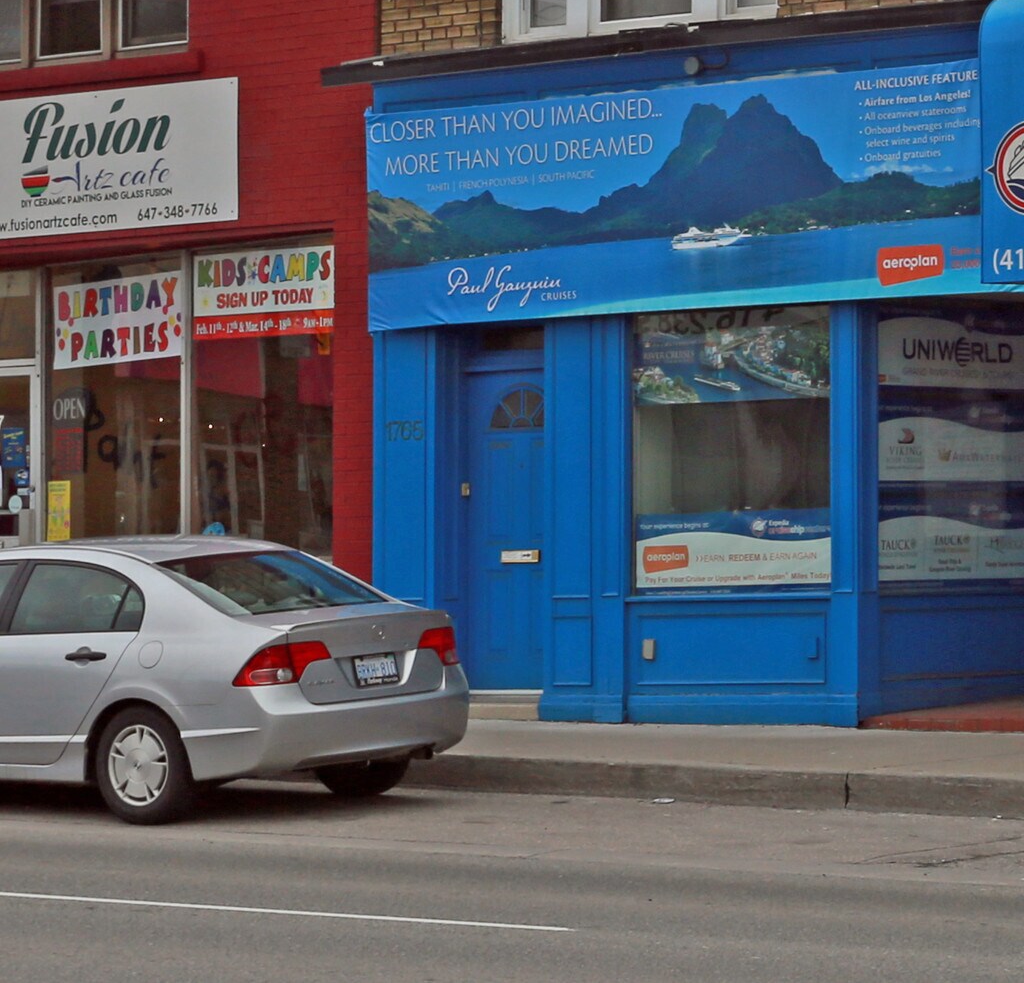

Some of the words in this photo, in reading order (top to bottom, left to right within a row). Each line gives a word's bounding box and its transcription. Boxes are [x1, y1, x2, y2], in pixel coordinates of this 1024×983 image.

[854, 75, 929, 91] ALL-INCLUSIVE
[863, 96, 895, 107] Airfare
[896, 94, 917, 105] from
[919, 93, 933, 102] Los
[934, 89, 971, 103] Angeles!
[864, 111, 876, 121] All
[877, 109, 919, 120] oceanview
[921, 105, 967, 117] staterooms
[22, 98, 171, 164] Fusion
[369, 117, 436, 144] CLOSER
[440, 113, 497, 137] THAN
[500, 106, 546, 131] YOU
[864, 124, 901, 136] Onboard
[902, 122, 943, 133] beverages
[866, 138, 889, 148] select
[891, 136, 911, 146] wine
[912, 134, 928, 144] and
[929, 133, 956, 145] spirits
[384, 151, 441, 177] MORE
[444, 147, 500, 172] THAN
[504, 142, 549, 166] YOU
[554, 132, 655, 163] DREAMED
[864, 152, 901, 163] Onboard
[902, 149, 941, 161] gratuities
[51, 160, 114, 193] Artz
[119, 157, 171, 187] cafe
[537, 171, 566, 183] SOUTH
[566, 168, 596, 181] PACIFIC
[20, 199, 32, 209] DIY
[34, 195, 67, 208] CERAMIC
[67, 193, 102, 205] PAINTING
[103, 190, 120, 202] AND
[121, 189, 145, 201] GLASS
[145, 186, 173, 199] FUSION
[137, 202, 219, 222] 647-348-7766
[198, 257, 247, 288] KIDS
[257, 250, 332, 285] CAMPS
[883, 254, 939, 271] aeroplan
[216, 292, 248, 309] SIGN
[251, 290, 269, 307] UP
[271, 287, 314, 305] TODAY
[447, 266, 493, 297] Paul
[486, 264, 562, 313] Gauguin
[540, 290, 577, 302] CRUISES
[57, 276, 179, 322] BIRTHDAY
[70, 320, 169, 363] PARTIES
[53, 397, 86, 421] OPEN
[385, 419, 426, 442] 1765
[880, 538, 912, 551] TAUCK
[646, 551, 686, 563] aeroplan
[728, 553, 761, 562] REDEEM
[762, 553, 768, 562] &
[769, 552, 791, 562] EARN
[792, 551, 817, 561] AGAIN
[645, 577, 657, 585] Pay
[658, 576, 669, 584] For
[670, 575, 686, 584] Your
[686, 574, 706, 583] Cruise
[707, 575, 714, 583] or
[715, 573, 741, 584] Upgrade
[742, 573, 755, 581] with
[791, 571, 808, 581] Miles
